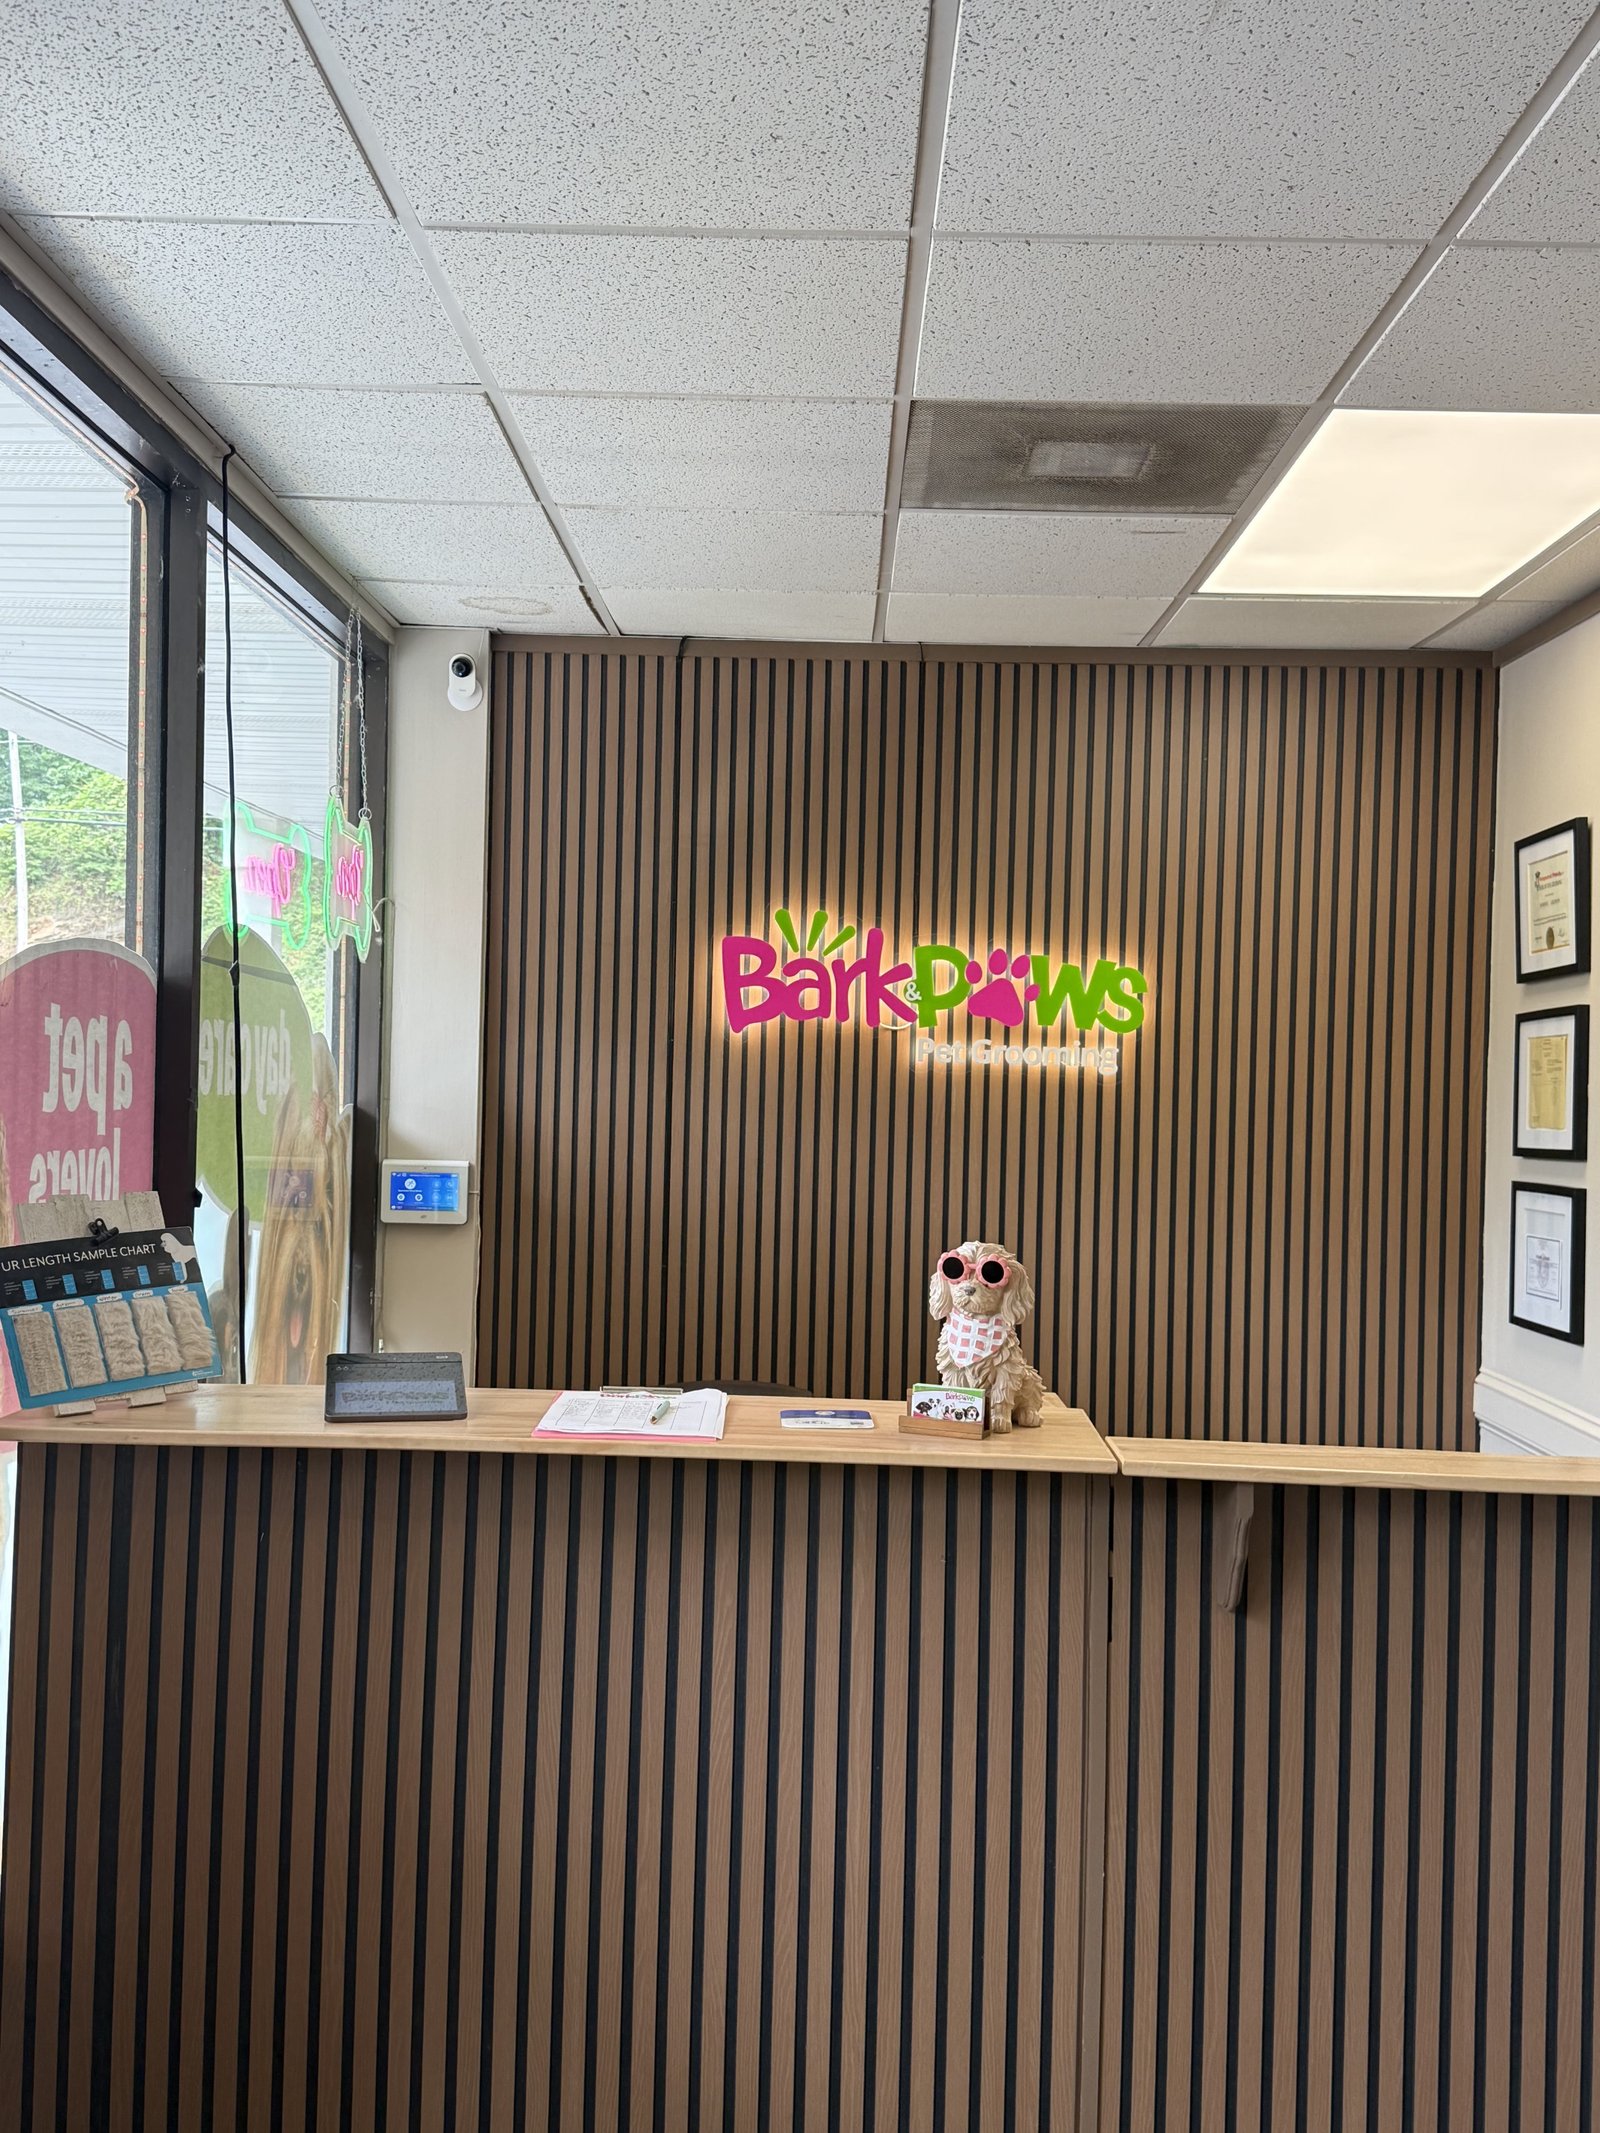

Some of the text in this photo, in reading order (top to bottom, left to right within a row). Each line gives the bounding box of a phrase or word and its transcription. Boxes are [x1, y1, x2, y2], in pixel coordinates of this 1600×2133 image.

[722, 927, 1148, 1034] Bark & Pws
[917, 1037, 1119, 1076] Pet Grooming
[0, 1243, 156, 1272] UR LENGTH SAMPLE CHART
